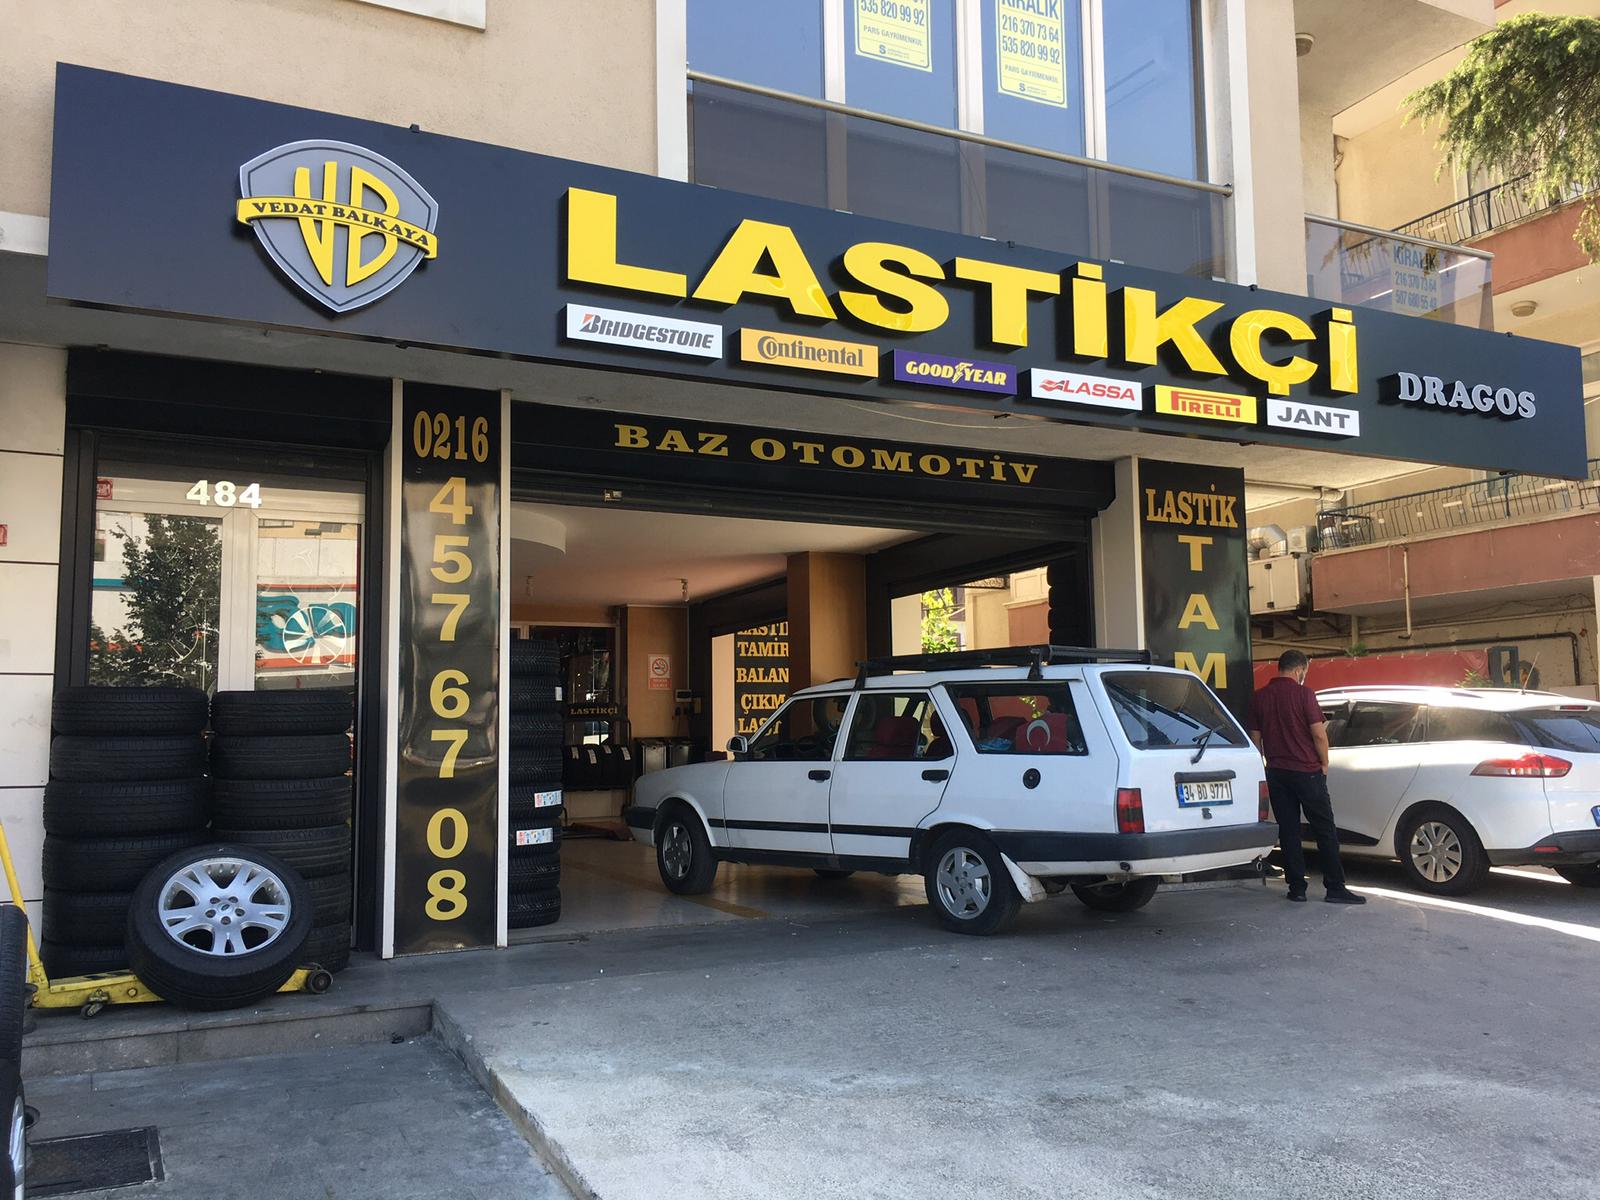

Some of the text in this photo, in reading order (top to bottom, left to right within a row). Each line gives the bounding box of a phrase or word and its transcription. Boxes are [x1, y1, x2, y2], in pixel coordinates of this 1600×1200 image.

[881, 0, 897, 19] 820
[900, 4, 911, 23] 99
[914, 8, 924, 26] 92
[1001, 0, 1059, 20] ALIK
[1002, 14, 1059, 43] 216 370 73 64
[1002, 35, 1060, 65] 535 820 99 92
[251, 202, 429, 246] VEDAT BALKAYA
[567, 187, 1358, 397] LASTİKÇİ
[578, 313, 714, 350] BRIDGESTONE
[757, 335, 863, 368] Continental
[1062, 379, 1136, 401] LASSA
[1170, 391, 1242, 419] PIRELLI
[1397, 371, 1537, 419] DRAGOS
[1277, 407, 1351, 430] JANT
[413, 410, 489, 463] 0216
[614, 423, 1039, 484] BAZ OTOMOTİV
[185, 479, 262, 509] 484
[1145, 483, 1239, 529] LASTİK
[736, 667, 790, 683] BALAN
[1183, 784, 1195, 801] 34
[1209, 782, 1230, 799] 9771
